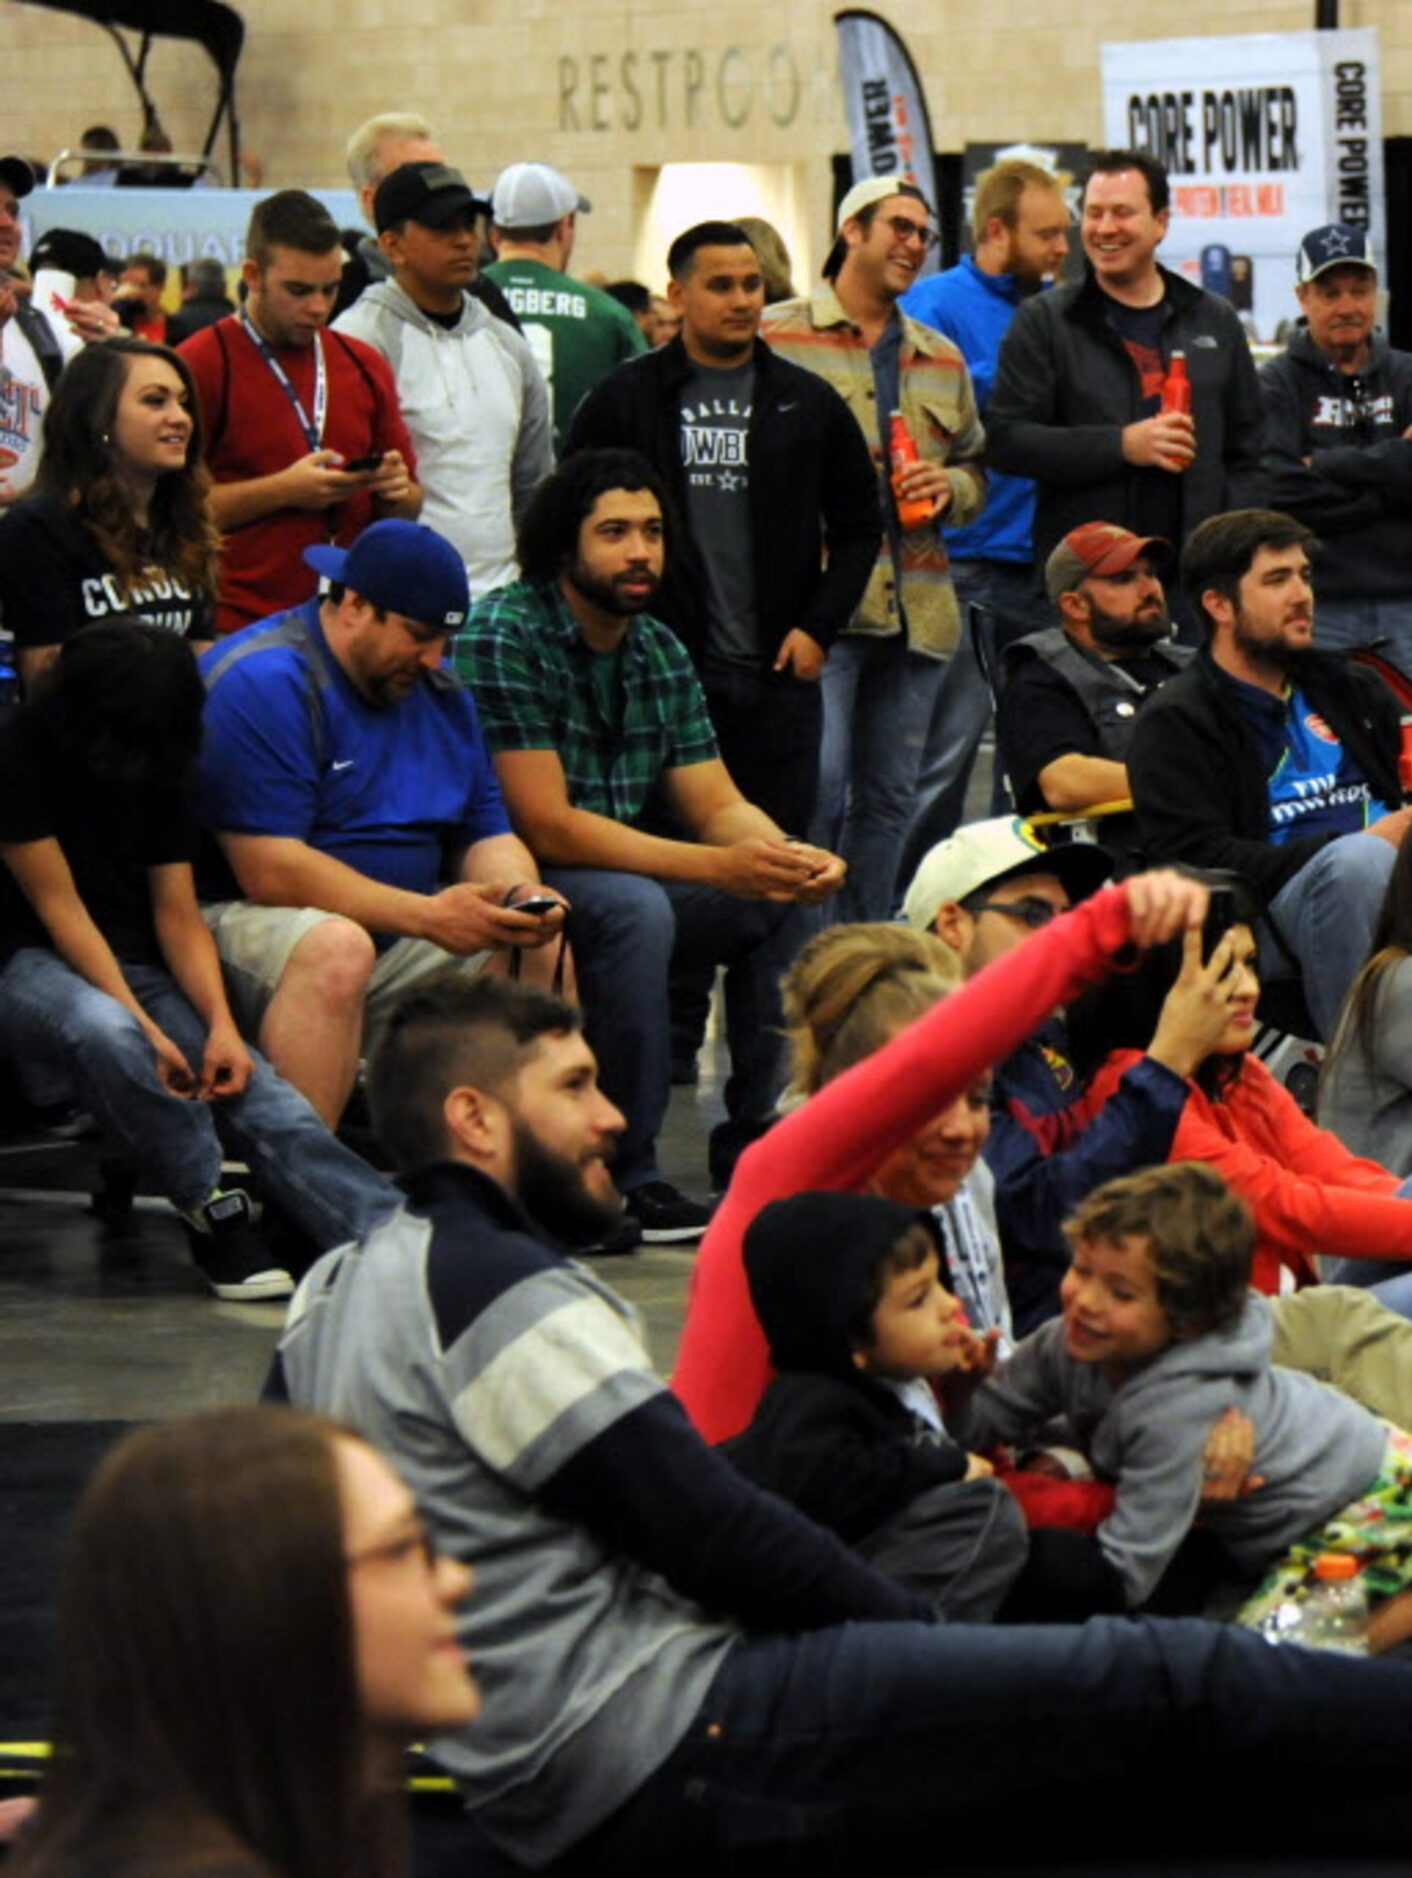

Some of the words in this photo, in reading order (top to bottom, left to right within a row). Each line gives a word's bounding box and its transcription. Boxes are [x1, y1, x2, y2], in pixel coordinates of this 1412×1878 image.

[861, 79, 898, 177] OWER
[1128, 91, 1196, 174] CORE
[1203, 86, 1299, 174] POWER
[1334, 61, 1368, 131] CORE
[501, 286, 587, 320] GBERG
